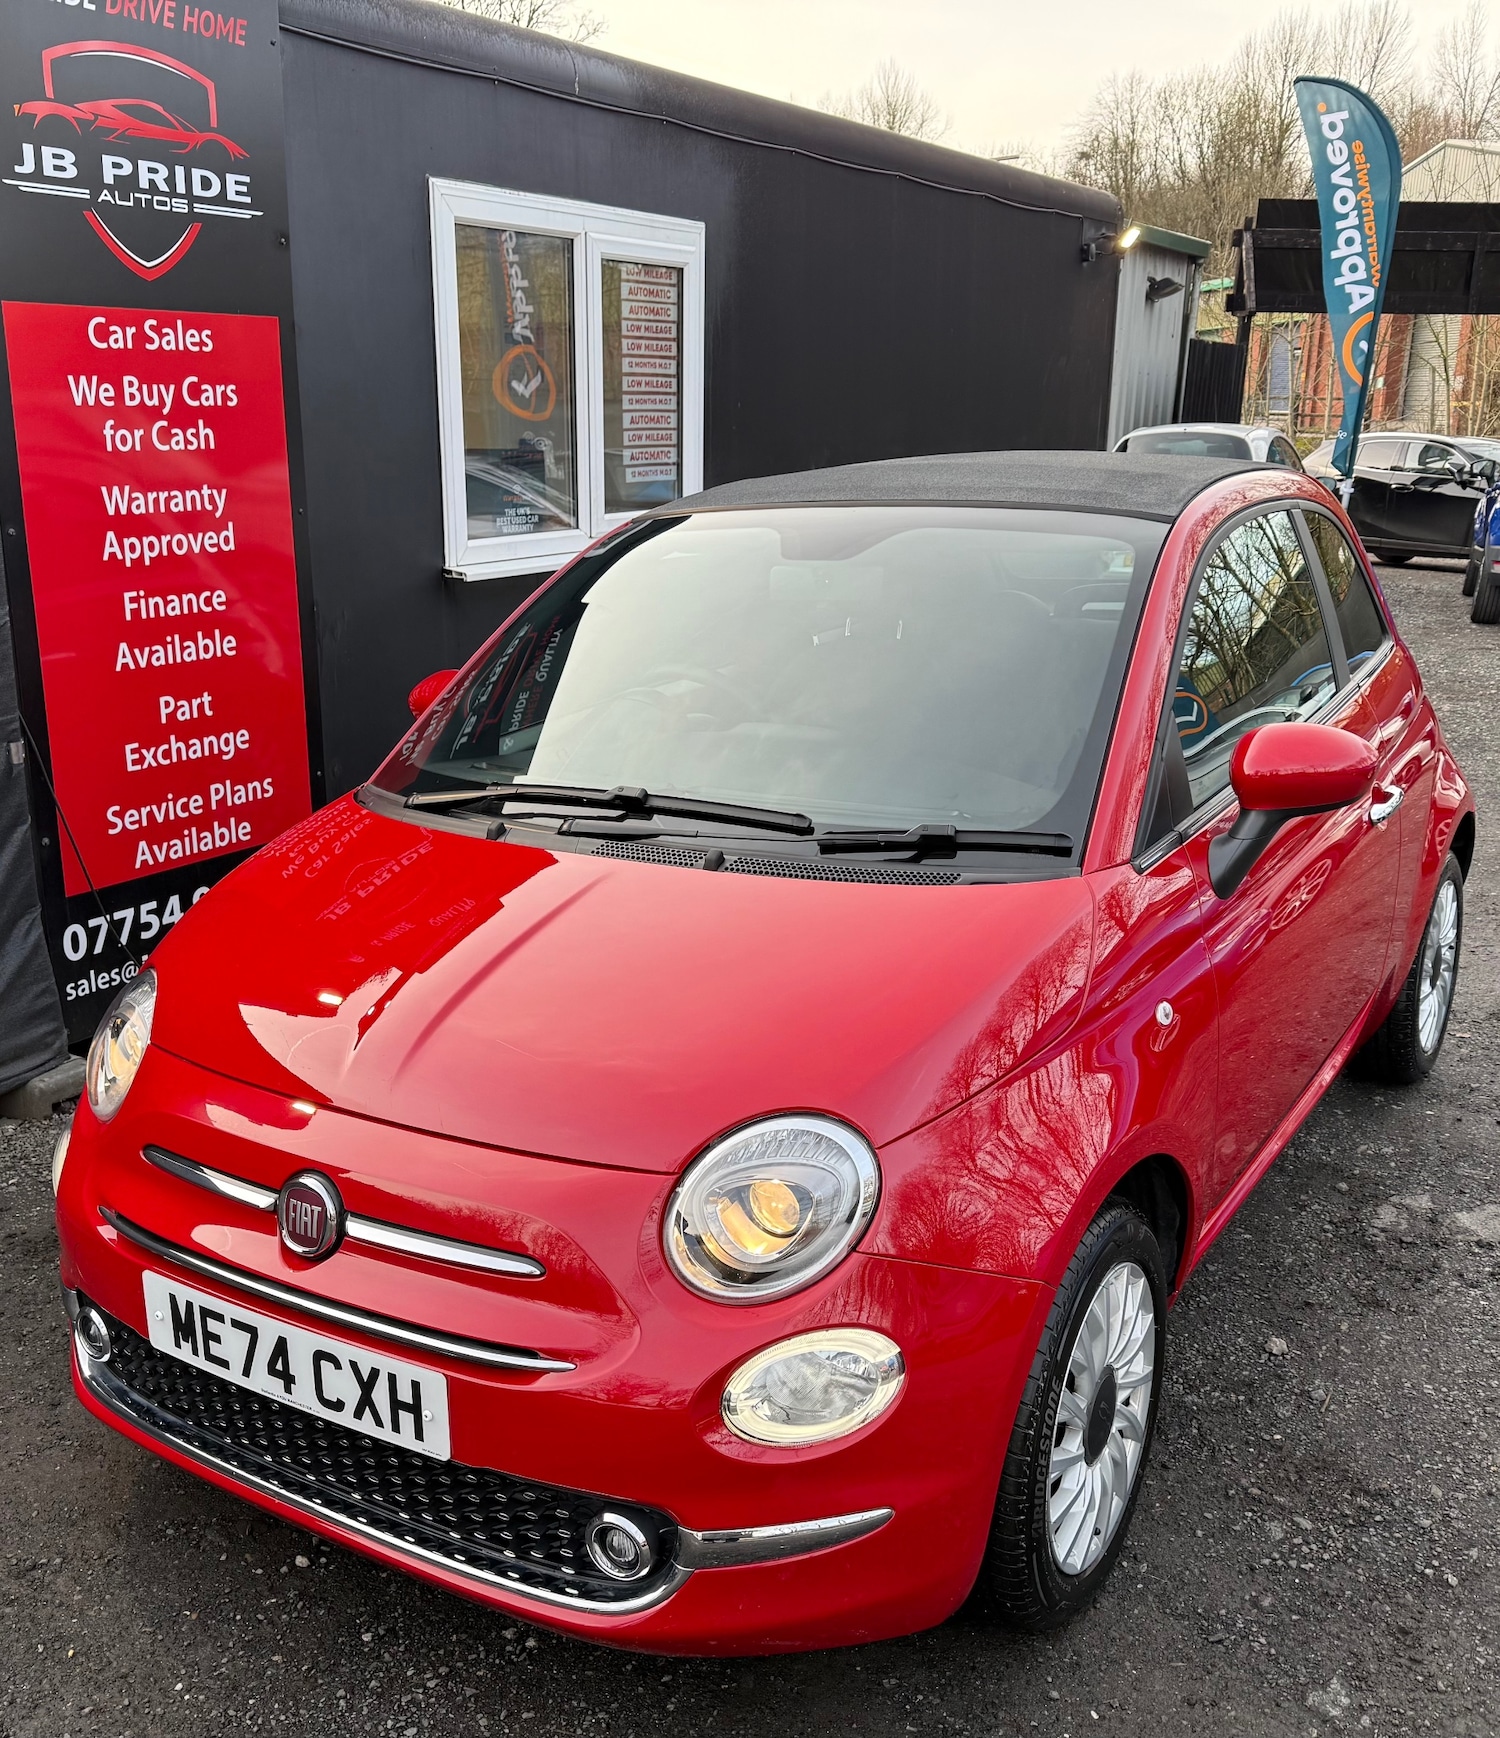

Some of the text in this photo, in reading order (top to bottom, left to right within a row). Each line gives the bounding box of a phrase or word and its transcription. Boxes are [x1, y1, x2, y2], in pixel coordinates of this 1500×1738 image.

[105, 0, 248, 46] DRIVE HOME
[14, 143, 251, 203] JB PRIDE
[98, 189, 188, 213] AUTOS
[644, 269, 672, 280] MILEAGE
[628, 286, 671, 299] AUTOMATIC
[628, 305, 671, 317] AUTOMATIC
[87, 316, 214, 352] Car Sales
[626, 324, 672, 334] LOW MILEAGE
[627, 342, 672, 352] LOW MILEAGE
[67, 375, 238, 415] We Buy Cars
[627, 380, 672, 389] LOW MILEAGE
[103, 419, 215, 452] for Cash
[630, 415, 671, 425] AUTOMATIC
[628, 433, 672, 442] LOW MILEAGE
[630, 450, 671, 462] AUTOMATIC
[101, 484, 227, 518] Warranty
[504, 508, 516, 516] THE
[496, 515, 539, 526] BEST USED CAR
[502, 524, 534, 534] WARRANTY
[102, 521, 236, 567] Approved
[123, 588, 227, 621] Finance
[115, 629, 237, 672] Available
[159, 691, 214, 724] Part
[125, 728, 250, 772] Exchange
[106, 776, 274, 835] Service Plans
[134, 817, 252, 869] Available
[63, 894, 184, 962] 07754
[65, 954, 148, 1001] sales@
[288, 1198, 322, 1239] FIAT
[169, 1292, 425, 1442] ME74 CXH
